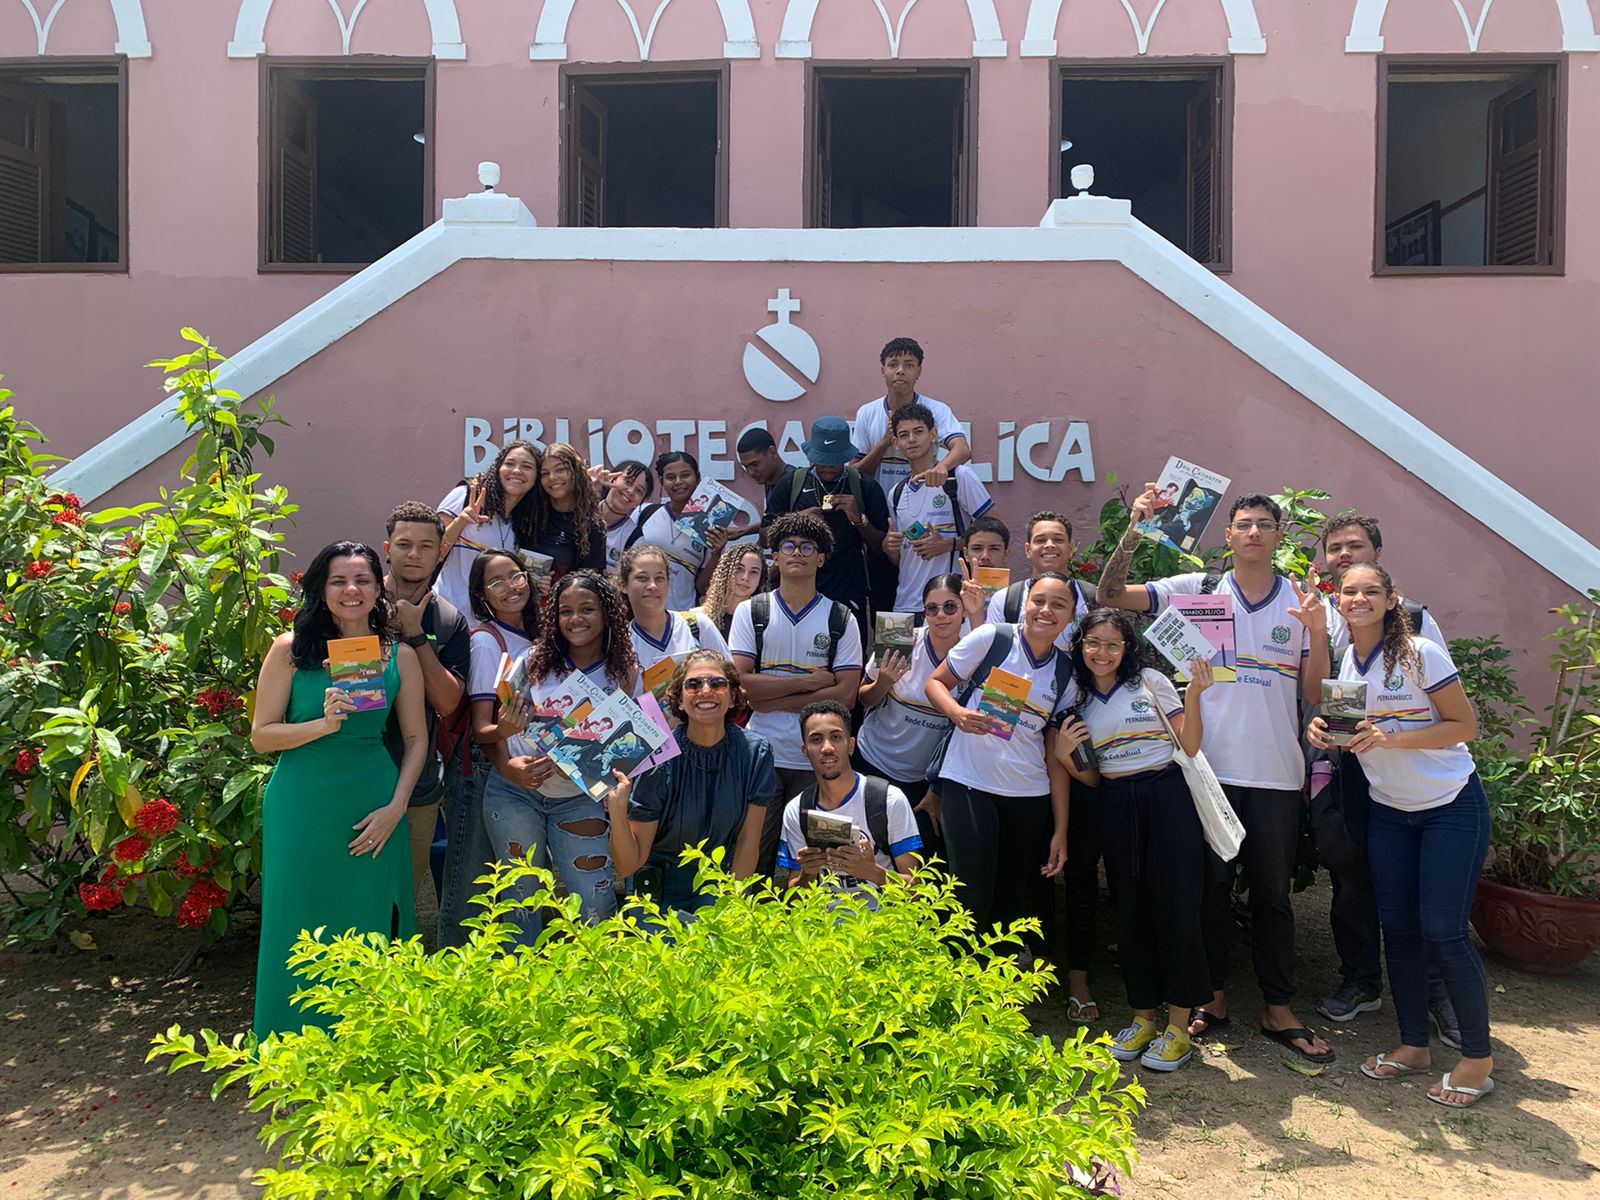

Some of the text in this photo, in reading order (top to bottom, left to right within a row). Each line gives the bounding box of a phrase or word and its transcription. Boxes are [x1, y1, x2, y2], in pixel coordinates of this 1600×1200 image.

[1170, 631, 1184, 646] CONTAM
[619, 696, 633, 712] Dom
[1377, 694, 1413, 702] PERNAMBUCO
[904, 715, 921, 727] Rede
[1018, 719, 1037, 731] adual
